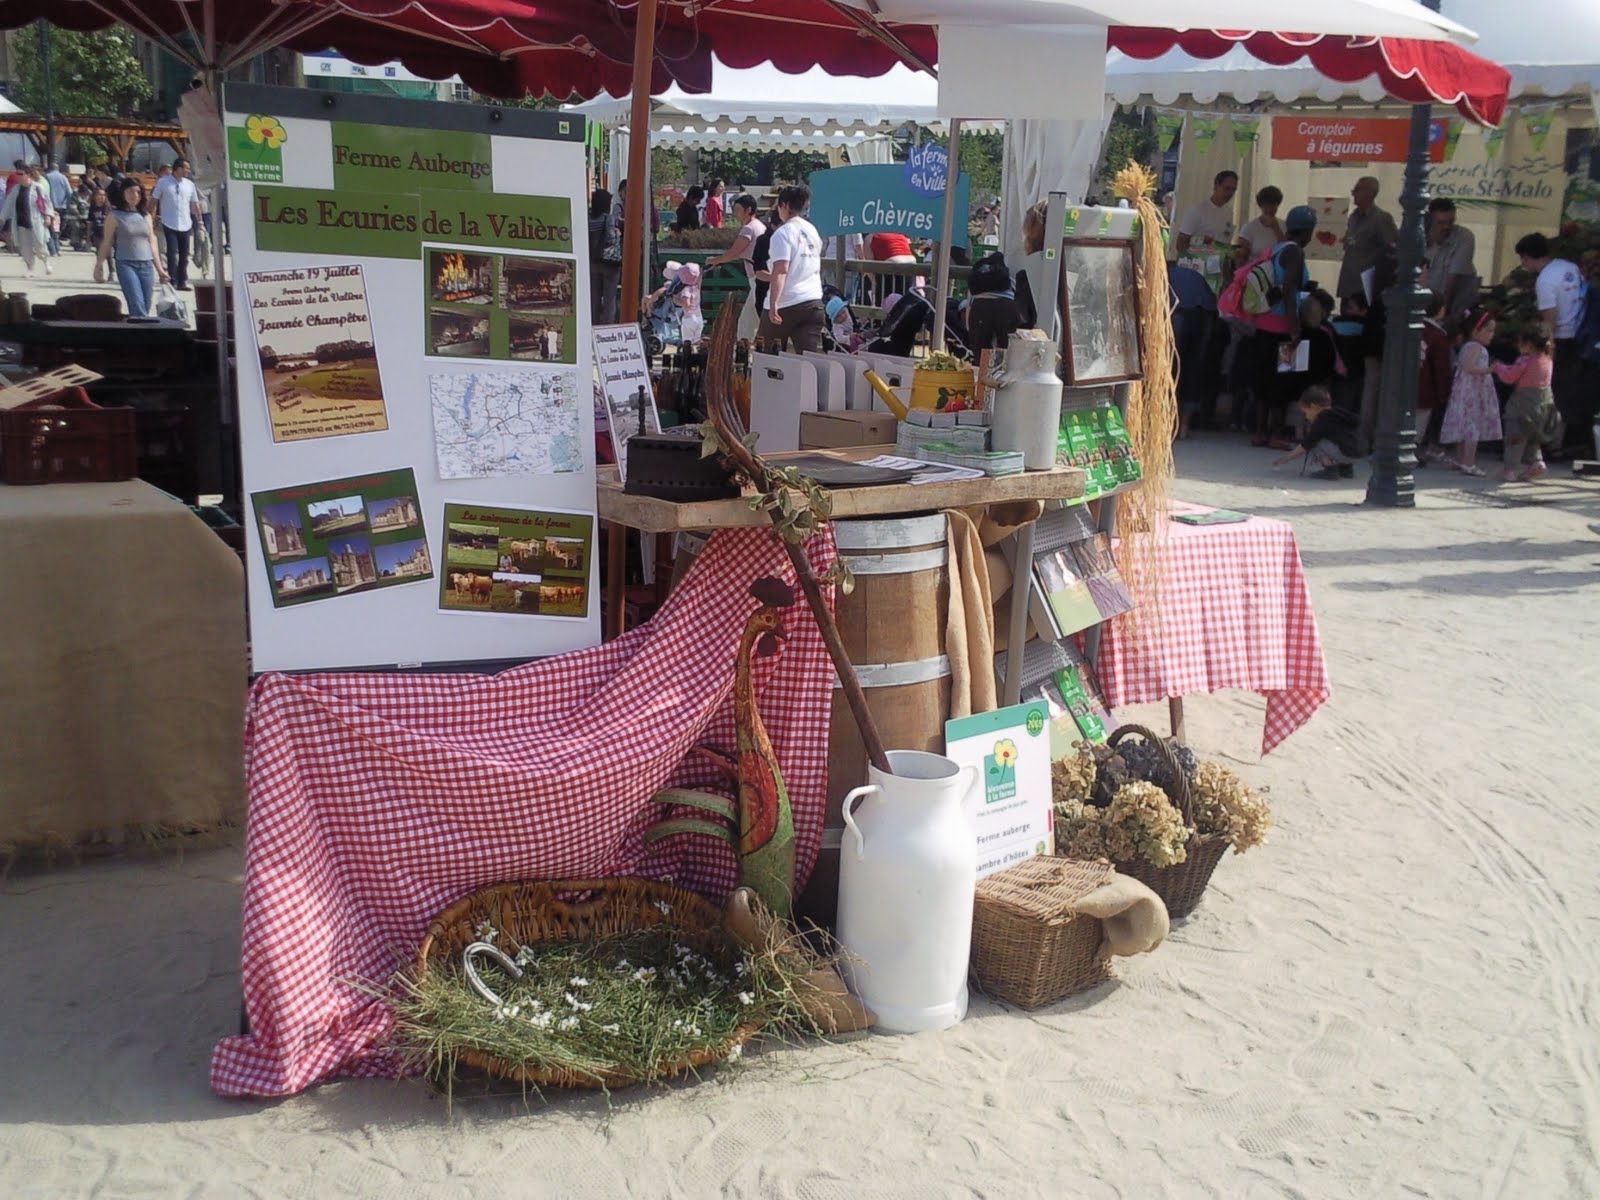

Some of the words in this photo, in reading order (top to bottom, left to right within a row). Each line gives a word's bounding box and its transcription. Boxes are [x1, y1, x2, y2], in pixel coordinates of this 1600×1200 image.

[1298, 122, 1355, 137] Comptoir
[910, 146, 922, 167] la
[922, 141, 949, 168] ferm
[1306, 142, 1315, 153] à
[1320, 141, 1383, 156] légumes
[234, 161, 281, 171] bienvenue
[335, 144, 401, 170] Ferme
[408, 151, 492, 178] Auberge
[234, 170, 241, 178] à
[254, 171, 281, 180] ferme
[911, 173, 921, 187] en
[922, 172, 947, 191] Ville
[1427, 182, 1455, 197] res
[1478, 180, 1553, 199] St-Malo
[257, 196, 308, 226] Les
[317, 200, 417, 233] Ecuries
[421, 210, 452, 236] de
[459, 214, 482, 237] la
[486, 214, 571, 243] Valière
[839, 209, 855, 227] les
[862, 199, 933, 231] Chèvres
[248, 270, 305, 284] Dimanche
[307, 268, 319, 280] 19
[324, 266, 360, 281] Juillet
[252, 298, 268, 309] Les
[271, 297, 303, 307] Ecuries
[306, 294, 317, 304] de
[318, 294, 329, 303] la
[258, 316, 304, 334] Journée
[306, 312, 368, 327] Champêtre
[976, 832, 1000, 844] Ferme
[1002, 823, 1031, 837] auberge
[976, 858, 1001, 872] ambre
[1003, 850, 1029, 863] d'hôtes
